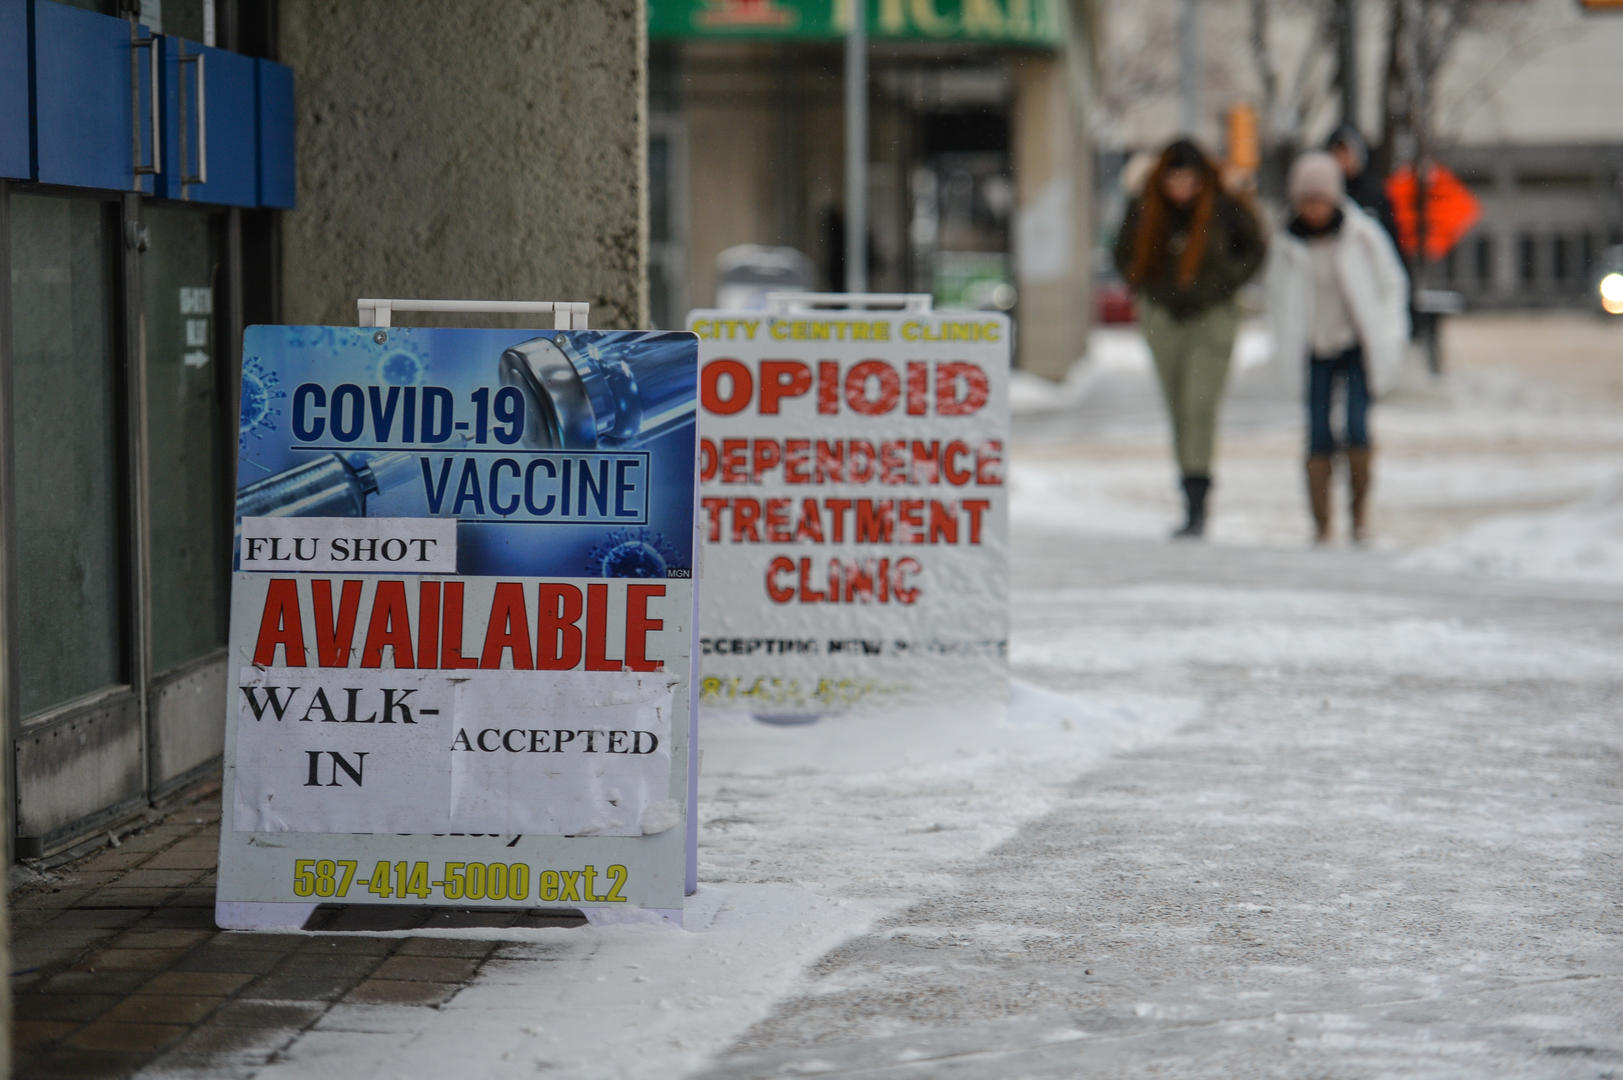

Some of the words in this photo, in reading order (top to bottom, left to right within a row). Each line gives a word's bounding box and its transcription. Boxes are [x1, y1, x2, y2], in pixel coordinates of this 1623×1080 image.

[692, 319, 760, 341] CITY
[769, 319, 892, 341] CENTRE
[902, 321, 1001, 342] CLINIC
[700, 358, 990, 417] OPIOID
[292, 382, 526, 445] COVID-19
[700, 439, 1004, 486] DEPENDENCE
[420, 457, 641, 517] VACCINE
[702, 498, 990, 544] TREATMENT
[245, 537, 318, 561] FLU
[330, 538, 437, 562] SHOT
[668, 569, 690, 577] MGN
[766, 556, 922, 604] CLINIC
[252, 578, 667, 672] AVAILABLE
[240, 686, 440, 724] WALK-
[450, 728, 659, 755] ACCEPTED
[303, 751, 369, 787] IN
[293, 859, 530, 901] 587-414-5000
[538, 864, 628, 902] ext.2
